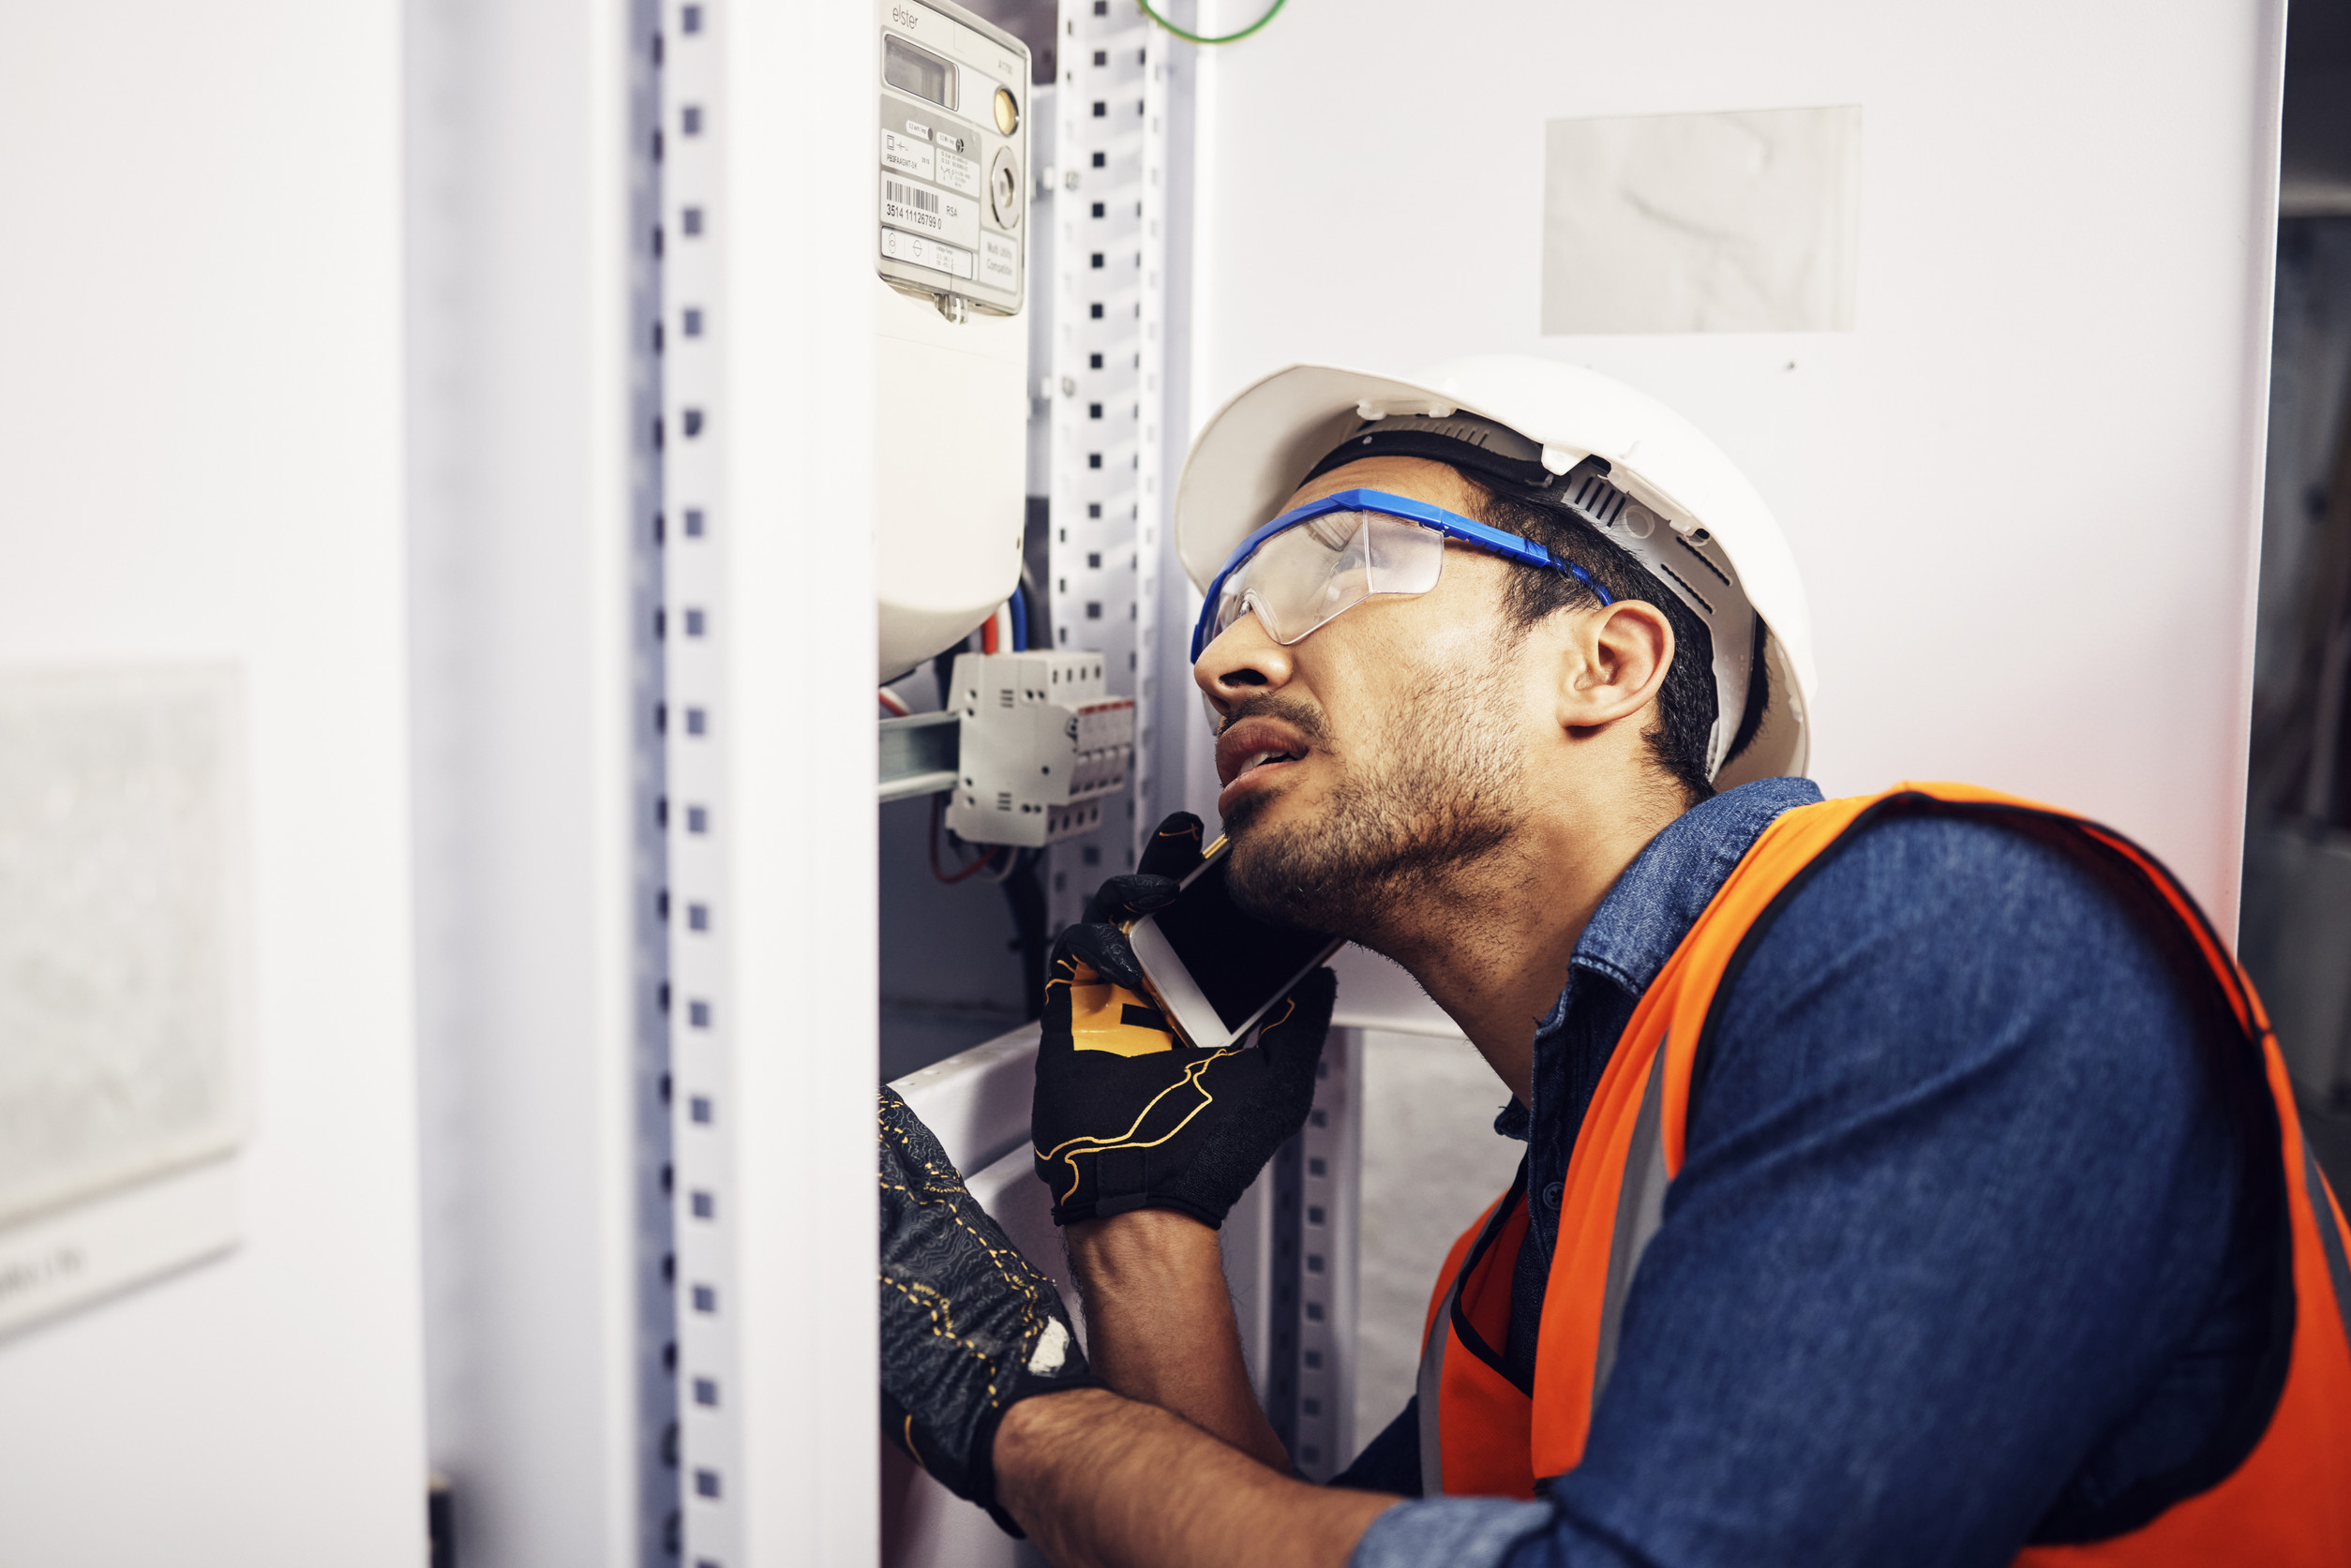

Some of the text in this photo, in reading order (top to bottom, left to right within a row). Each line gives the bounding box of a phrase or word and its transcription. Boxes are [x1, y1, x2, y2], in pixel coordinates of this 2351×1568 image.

[892, 5, 919, 29] elster
[887, 203, 904, 218] 3514
[906, 208, 936, 229] 11126799
[946, 205, 958, 217] RSA
